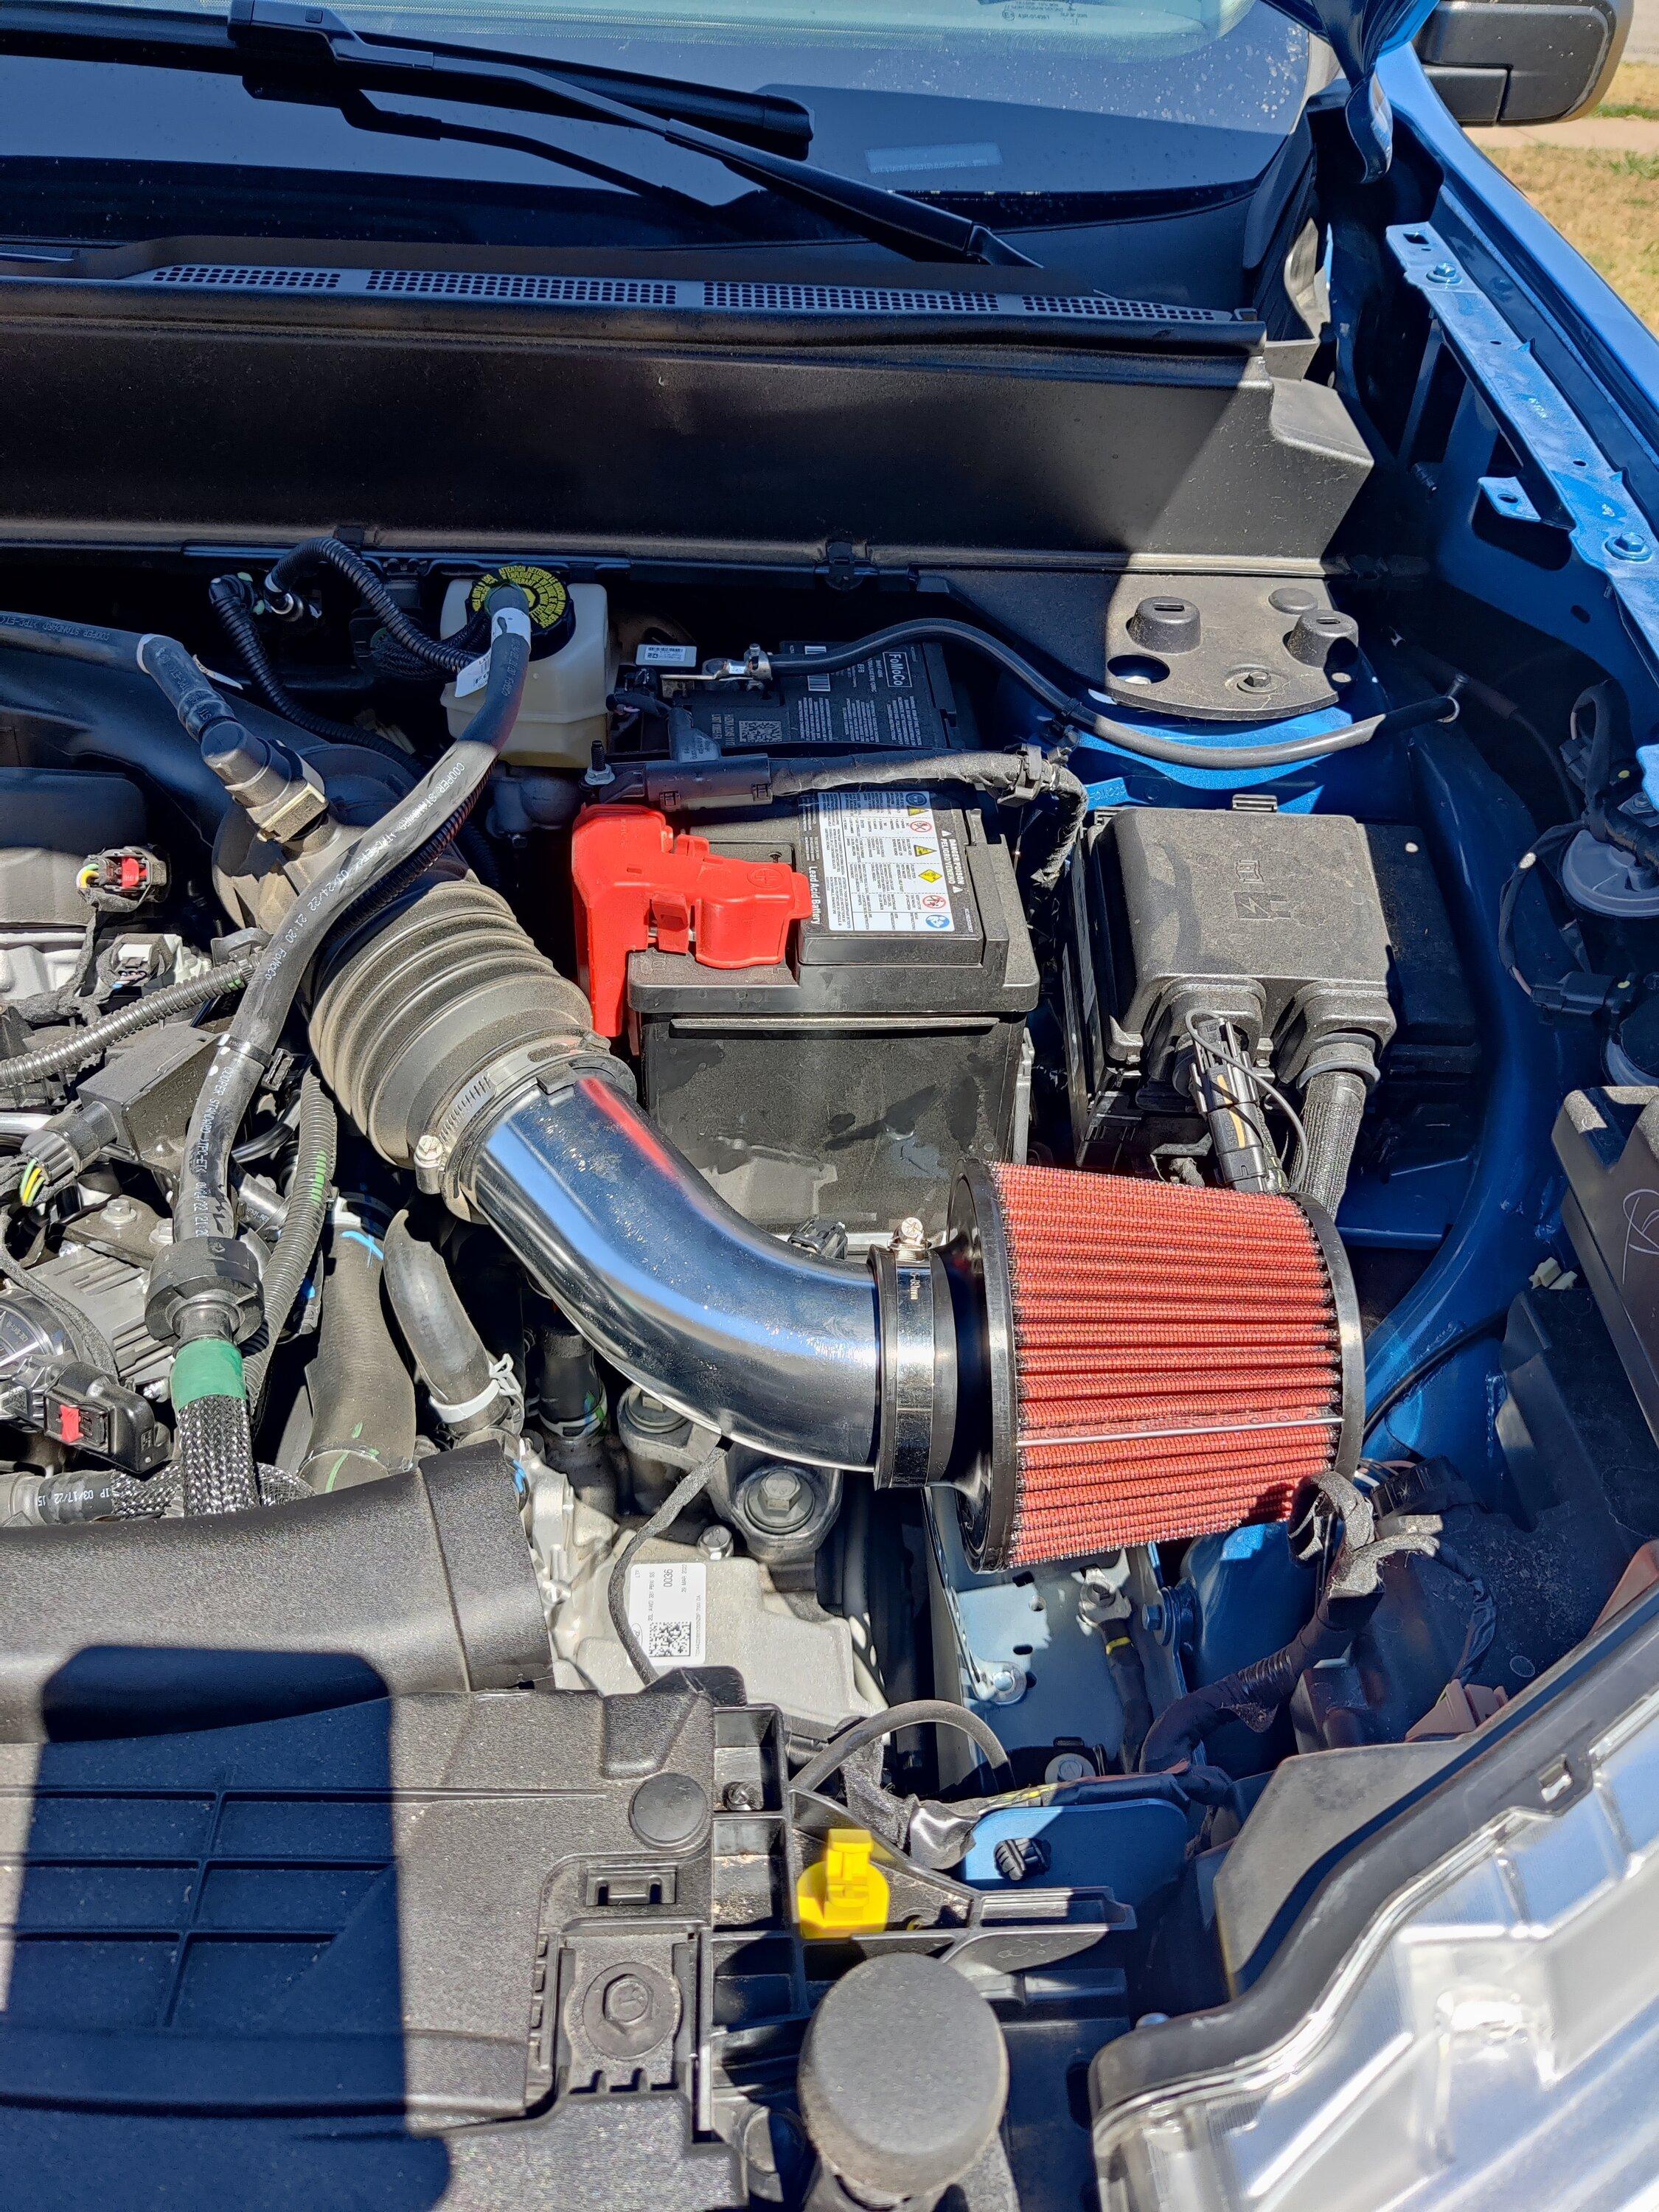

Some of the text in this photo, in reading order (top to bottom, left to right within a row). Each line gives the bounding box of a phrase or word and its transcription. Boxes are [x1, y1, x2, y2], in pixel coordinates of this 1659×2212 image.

[889, 654, 905, 686] FoMoCo
[438, 762, 466, 794] COOPER
[400, 793, 438, 831] STANDARD
[808, 866, 817, 883] Lead
[949, 839, 965, 885] DANGER/POISON
[810, 883, 819, 898] Acid
[810, 900, 821, 925] Battery
[265, 948, 288, 981] FoMoCo
[213, 1066, 234, 1096] COOPER
[200, 1097, 220, 1135] STANDARD
[54, 1489, 94, 1504] 03/17/22
[663, 1569, 673, 1587] 0036
